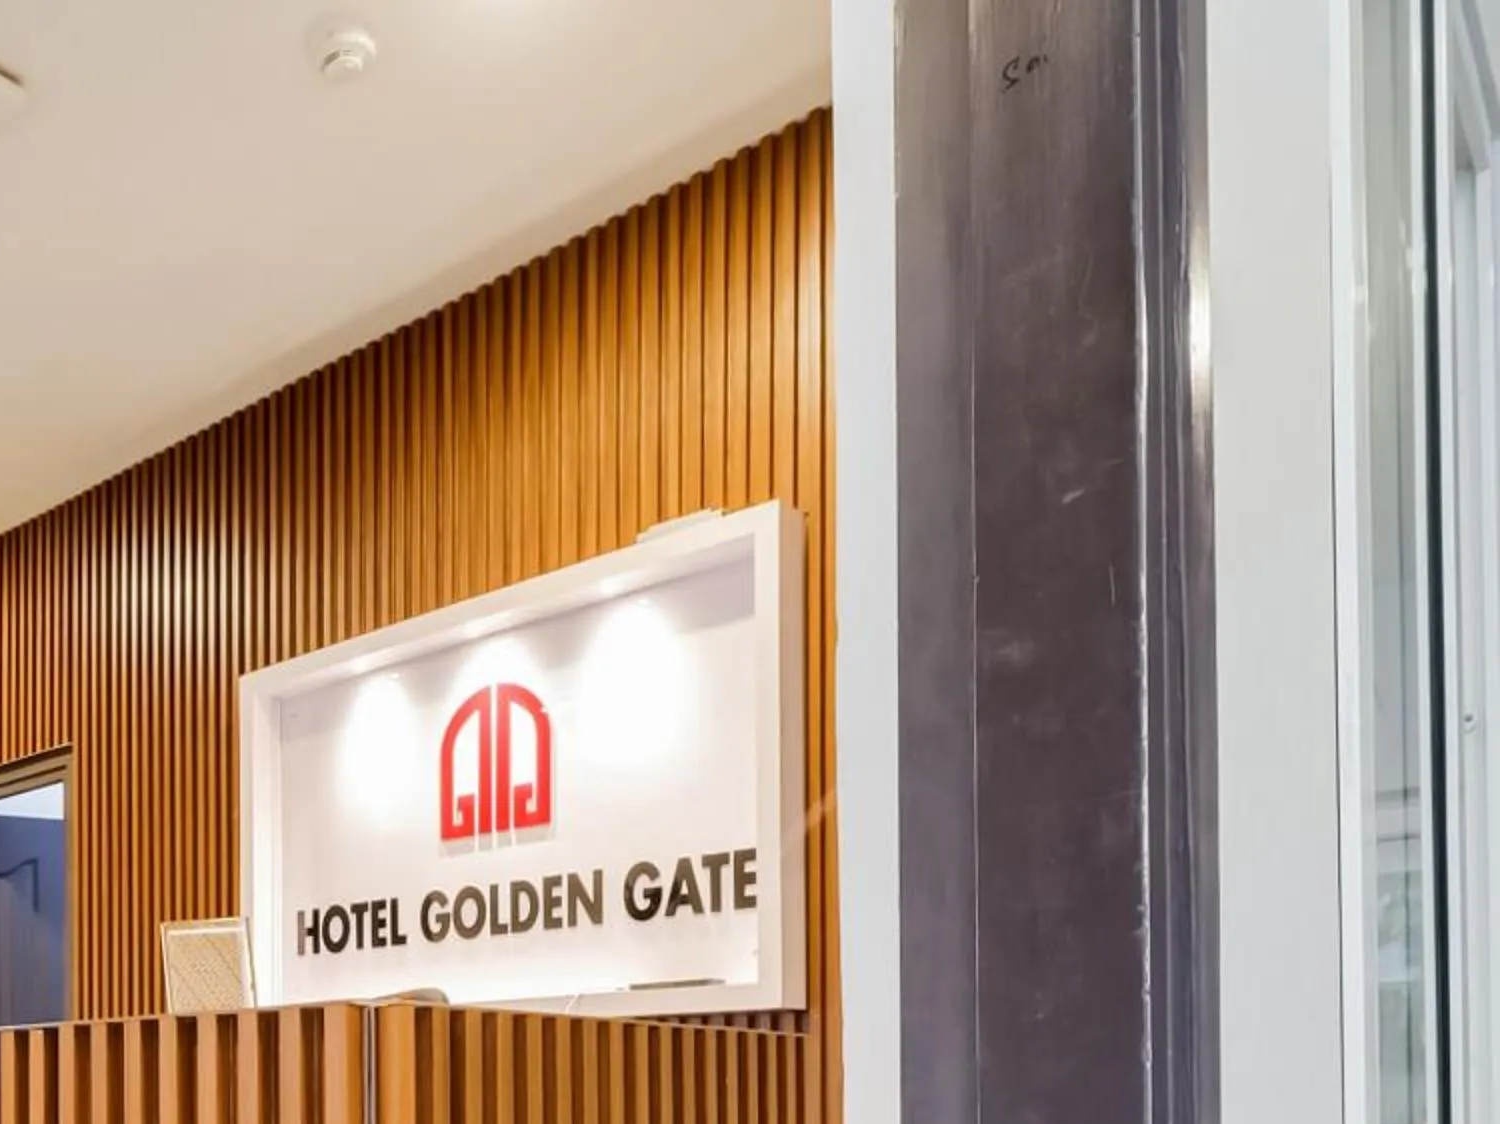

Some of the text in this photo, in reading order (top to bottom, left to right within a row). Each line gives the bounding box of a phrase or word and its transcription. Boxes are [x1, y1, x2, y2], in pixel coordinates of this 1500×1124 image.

[297, 847, 757, 956] HOTEL GOLDEN GATE
